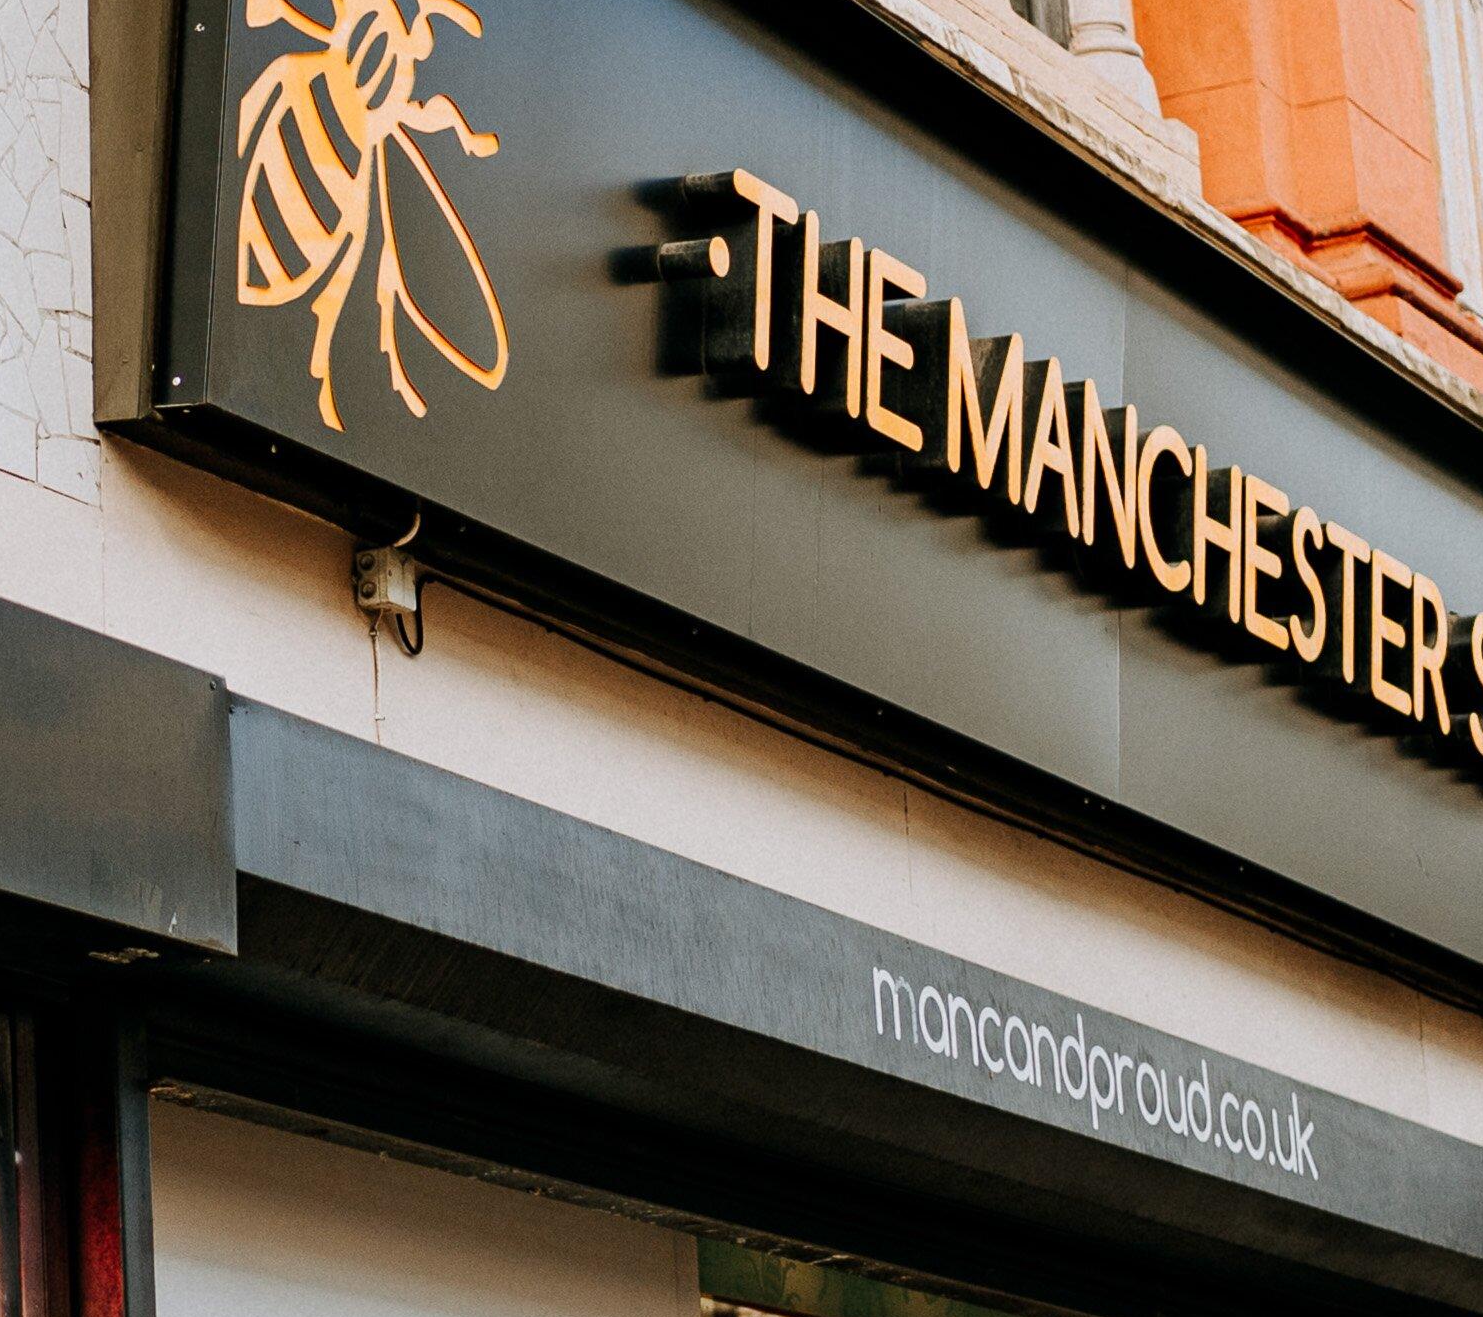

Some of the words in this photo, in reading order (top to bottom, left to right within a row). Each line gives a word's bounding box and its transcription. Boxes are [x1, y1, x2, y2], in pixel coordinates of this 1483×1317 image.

[733, 168, 928, 453] THE
[947, 296, 1451, 737] MANCHESTER
[872, 966, 1321, 1181] mancandproud.co.uk
